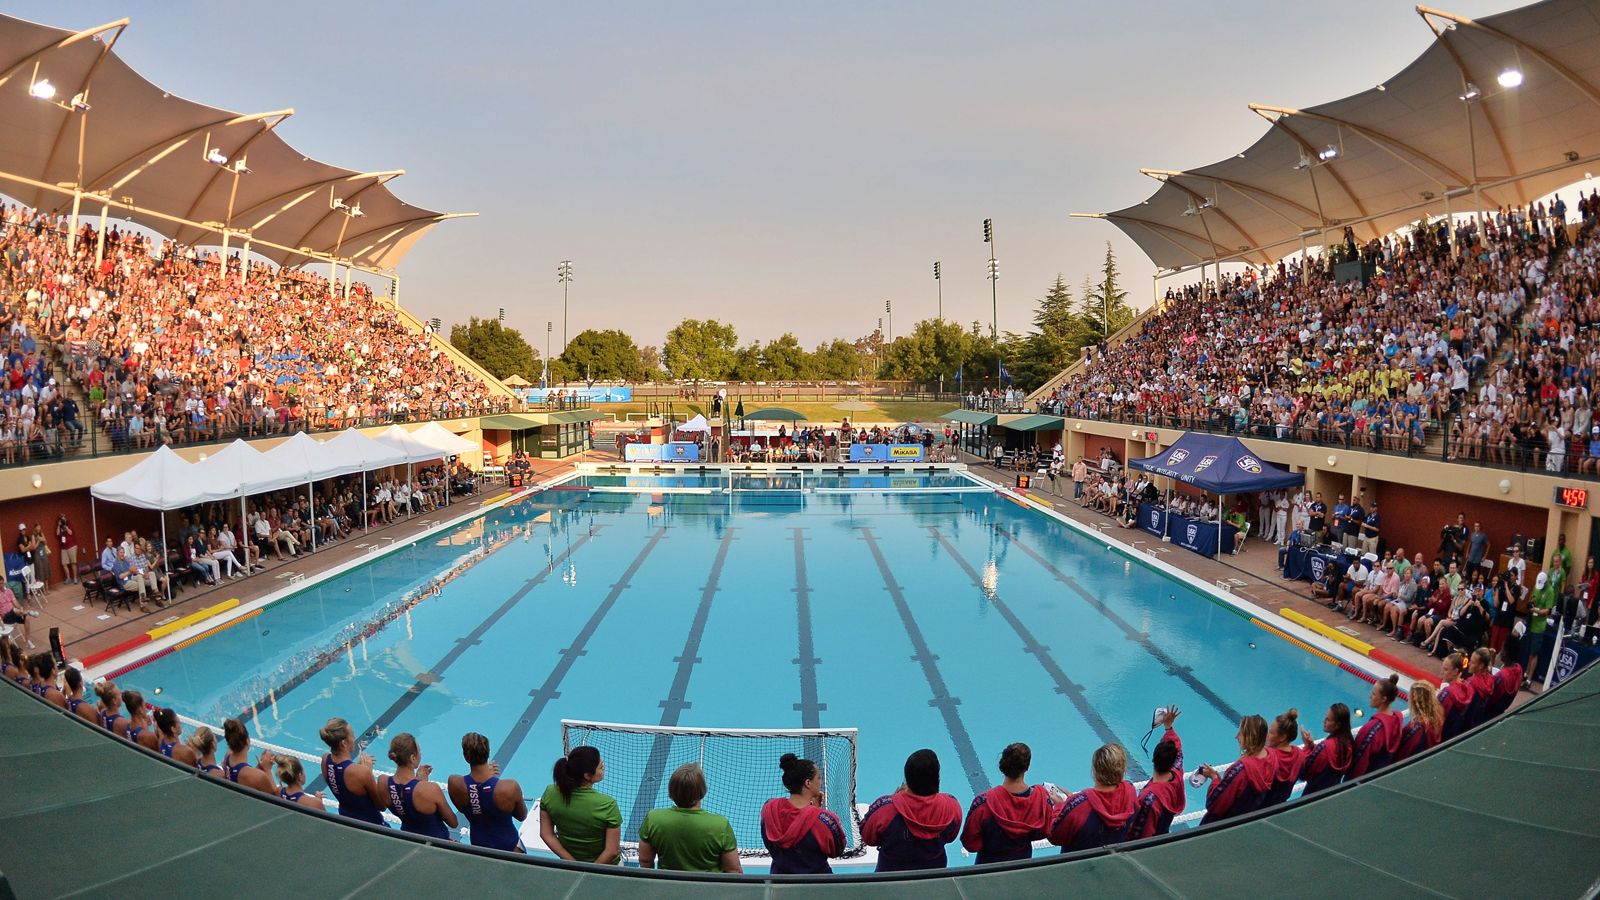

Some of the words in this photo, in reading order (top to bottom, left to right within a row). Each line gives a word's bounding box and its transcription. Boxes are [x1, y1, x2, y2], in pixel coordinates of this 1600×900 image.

[1180, 473, 1196, 483] UNITY
[1563, 489, 1586, 507] 4:59
[1560, 653, 1573, 666] USA
[328, 764, 340, 794] RUSSIA
[389, 784, 406, 815] RUSSIA
[469, 784, 483, 815] RUSSIA
